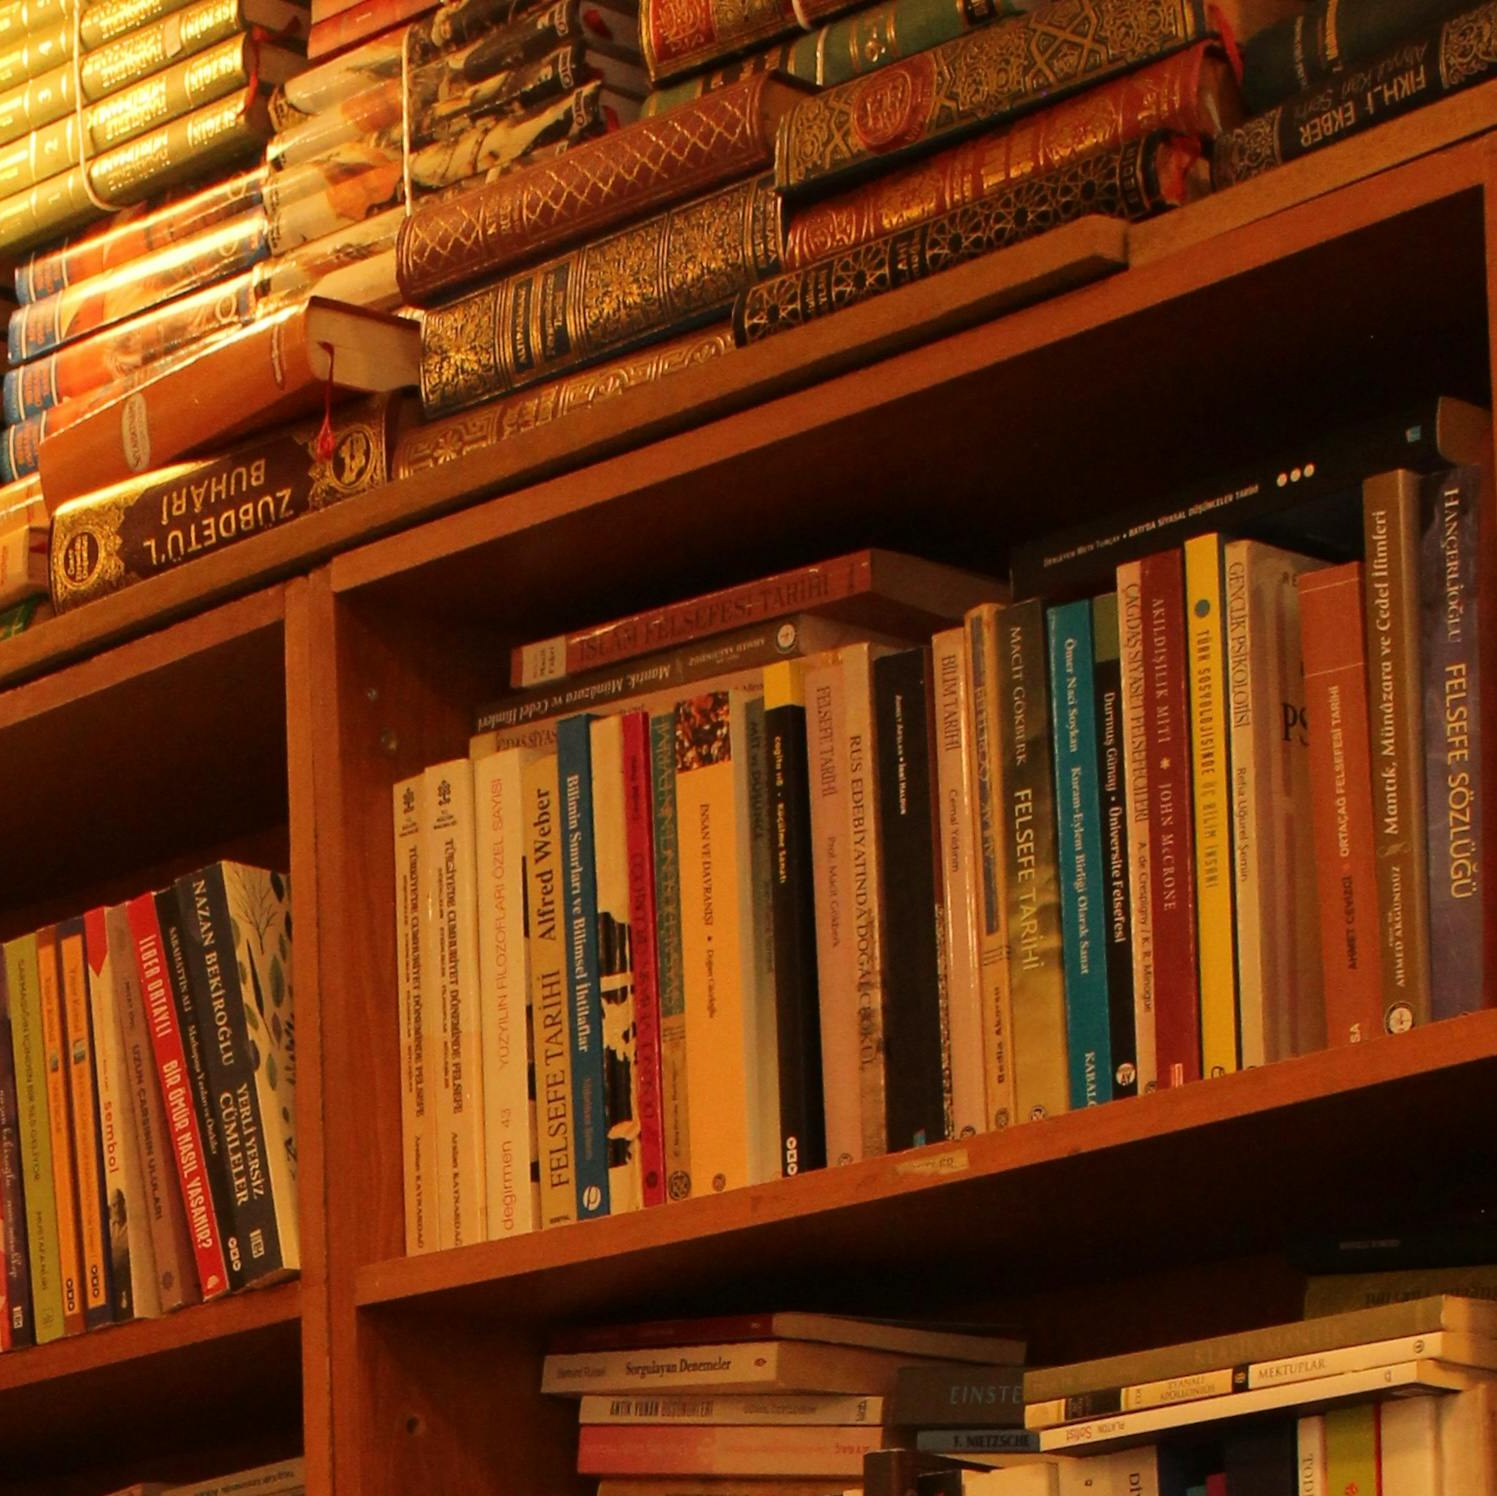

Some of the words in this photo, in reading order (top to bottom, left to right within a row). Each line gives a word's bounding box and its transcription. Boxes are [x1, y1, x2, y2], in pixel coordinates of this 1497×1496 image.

[1300, 102, 1355, 148] EKBER
[142, 485, 295, 568] ZÜBDETÜ'L
[1441, 487, 1465, 644] HANÇERLİOĞLU
[1009, 626, 1026, 681] MACİT
[1013, 686, 1031, 766] GÖKBERK
[1443, 662, 1469, 766] FELSEFE
[534, 788, 554, 862] Weber
[1013, 788, 1038, 882] FELSEFE
[1444, 772, 1477, 898] SÖZLÜĞÜ
[191, 880, 215, 946] NAZAN
[536, 871, 558, 941] Alfred
[1018, 889, 1044, 971] TARİHİ
[201, 952, 236, 1067] BEKİROĞLU
[539, 972, 563, 1060] TARİHİ
[234, 1083, 254, 1132] YERLİ
[542, 1069, 570, 1188] FELSEFE
[217, 1092, 249, 1206] CÜMLELER
[243, 1134, 263, 1199] YERSİZ
